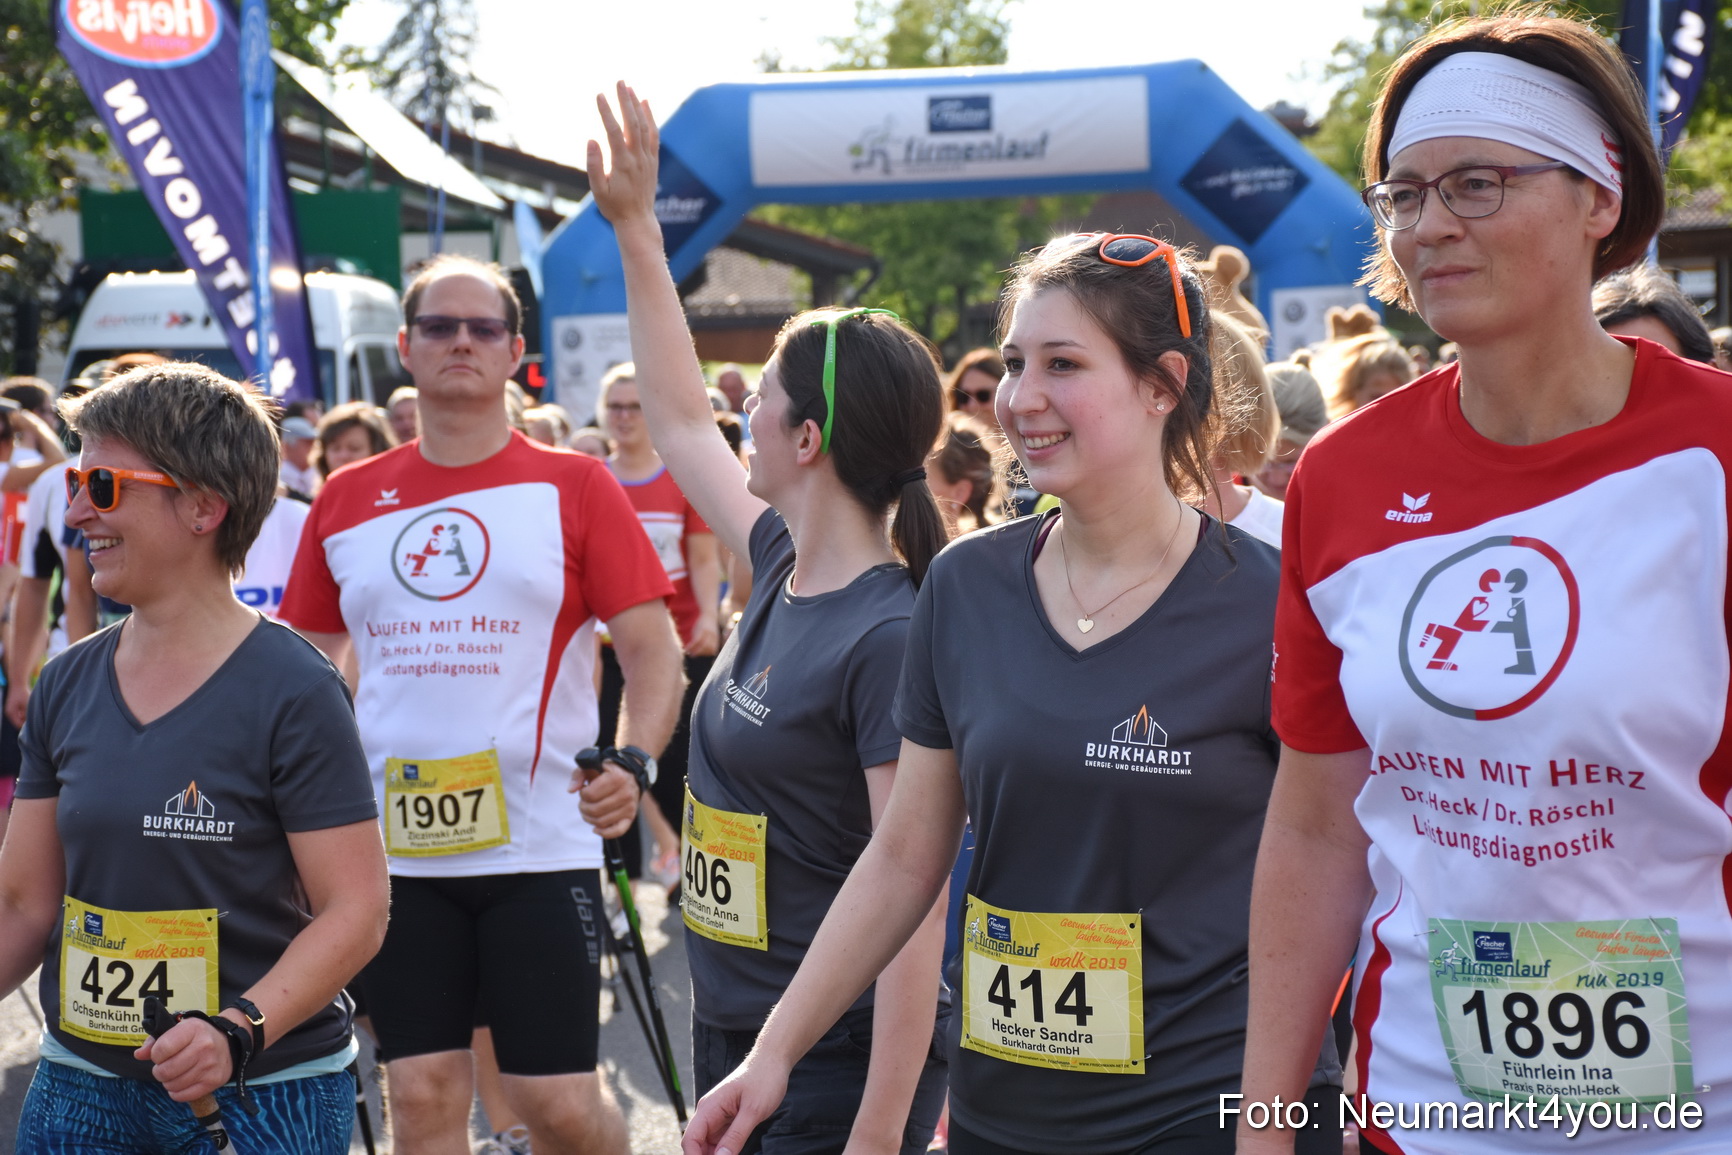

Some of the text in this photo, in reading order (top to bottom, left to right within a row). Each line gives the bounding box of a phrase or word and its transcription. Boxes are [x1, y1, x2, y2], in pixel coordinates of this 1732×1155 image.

[905, 131, 1049, 163] firmenlauf
[1385, 509, 1433, 523] erima
[366, 616, 521, 637] LAUFEN MIT HERZ
[394, 642, 422, 656] Heck
[435, 643, 454, 654] Dr.
[457, 643, 503, 654] Röschl
[1086, 742, 1192, 766] BURKHARDT
[1085, 760, 1113, 769] ENERGIE-
[1131, 765, 1192, 775] GEBÄUDETECHNIK
[1480, 758, 1531, 788] MIT
[1550, 758, 1646, 790] HERZ
[396, 788, 484, 829] 1907
[1429, 791, 1478, 816] Heck
[1495, 803, 1522, 826] Dr.
[1529, 798, 1614, 826] Röschl
[144, 815, 235, 834] BURKHARDT
[143, 830, 168, 838] ENERGIE-
[182, 833, 233, 842] GEBÄUDETECHNIK
[1413, 814, 1615, 868] Leistungsdiagnostik
[729, 849, 755, 862] 2019
[685, 845, 731, 905] 406
[570, 887, 596, 937] cep
[713, 906, 739, 922] Anna
[706, 918, 725, 930] GmbH
[1060, 918, 1096, 931] Gesunde
[1098, 923, 1127, 935] Firmen
[77, 928, 127, 950] firmenlauf
[135, 944, 168, 959] walk
[171, 947, 205, 958] 2019
[1076, 930, 1136, 950] laufen länger!
[1481, 927, 1661, 948] Fischer Gesunde Firmen
[1597, 941, 1630, 955] laufen
[980, 932, 1040, 957] firmenlauf
[1050, 951, 1085, 969] walk
[1089, 957, 1127, 970] 2019
[81, 956, 174, 1007] 424
[1461, 957, 1664, 989] firmenlauf run 2019
[1463, 976, 1499, 984] neumarkt
[988, 964, 1093, 1027] 414
[73, 1001, 140, 1022] Ochsenkühn
[89, 1020, 128, 1033] Burkhardt
[992, 1018, 1093, 1044] Hecker Sandra
[1462, 990, 1651, 1060] 1896
[1002, 1037, 1080, 1056] Burkhardt GmbH
[1503, 1061, 1613, 1080] Führlein Ina
[1502, 1079, 1621, 1096] Praxis Röschl-Heck
